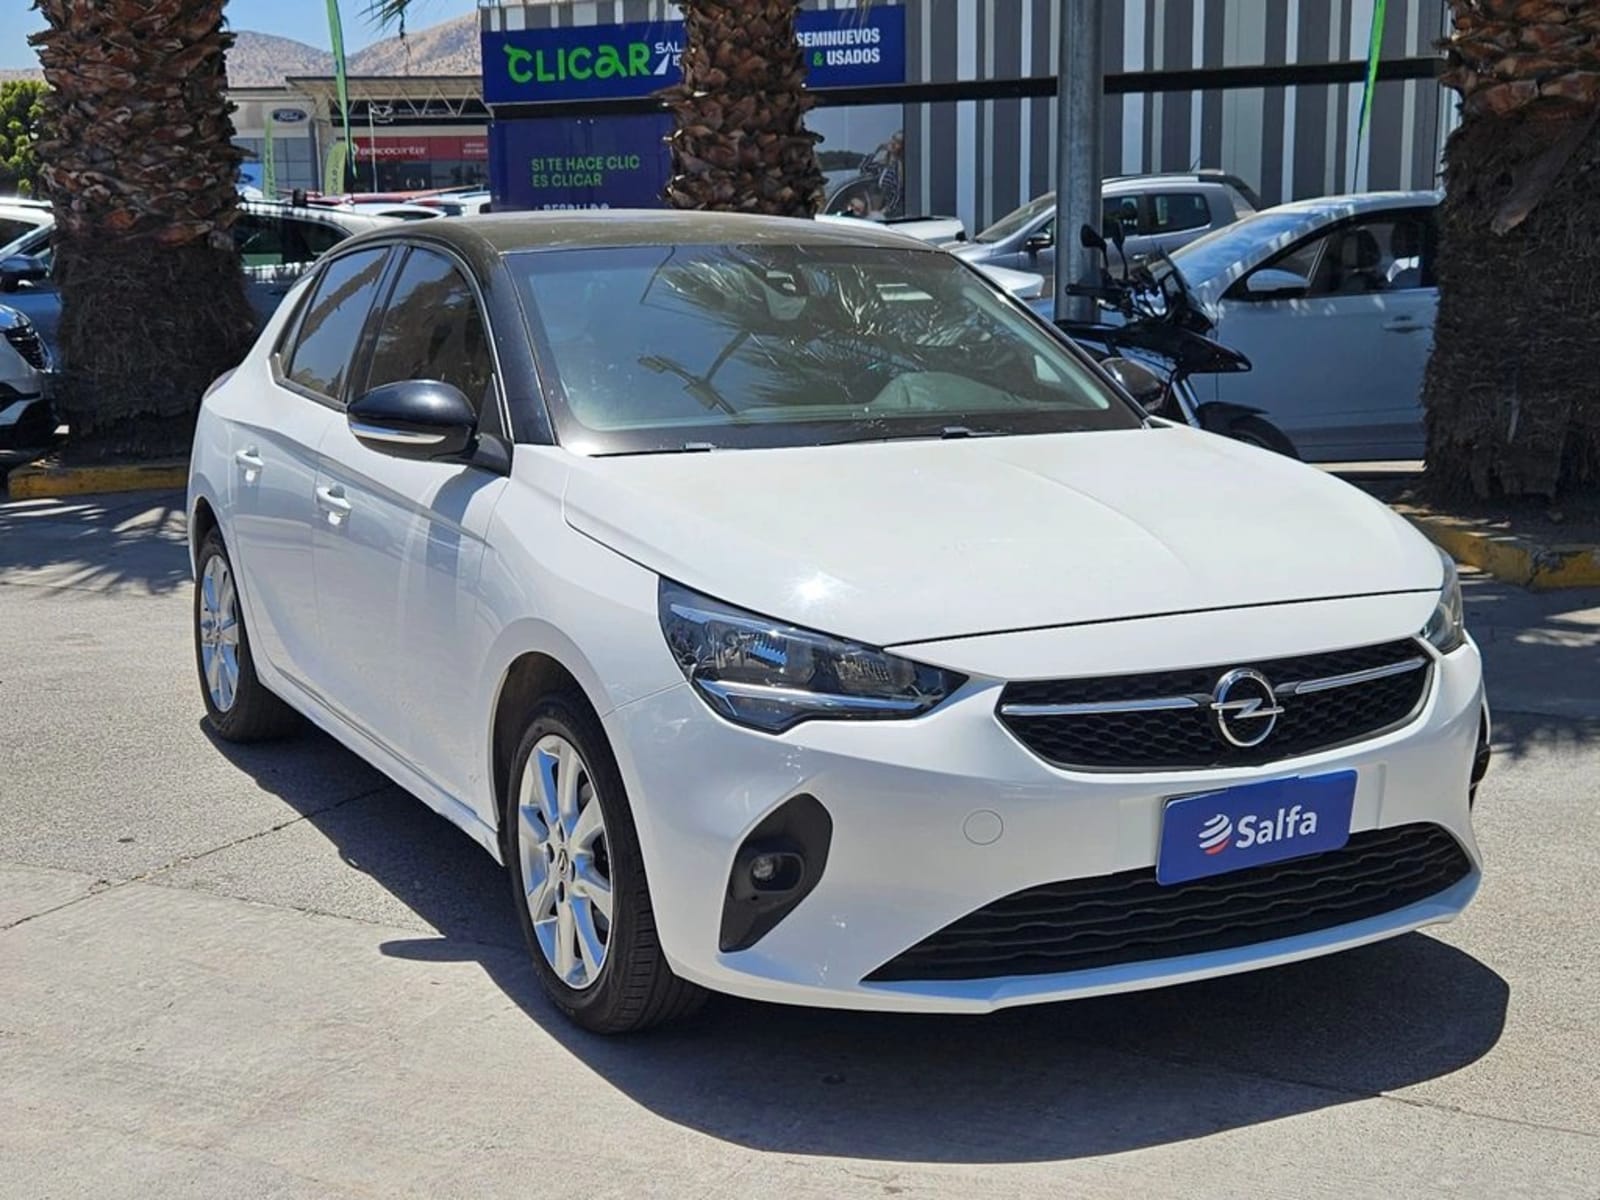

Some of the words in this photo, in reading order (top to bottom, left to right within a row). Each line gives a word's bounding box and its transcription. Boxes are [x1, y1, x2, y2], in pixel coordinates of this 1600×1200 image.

[795, 27, 881, 48] SEMINUEVOS
[812, 53, 824, 67] &
[826, 48, 881, 67] USADOS
[531, 157, 545, 172] SI
[548, 157, 562, 172] TE
[566, 156, 604, 171] HACE
[606, 155, 641, 170] CLIC
[532, 174, 549, 188] ES
[551, 172, 603, 187] CLICAR
[1235, 805, 1318, 849] Salfa
